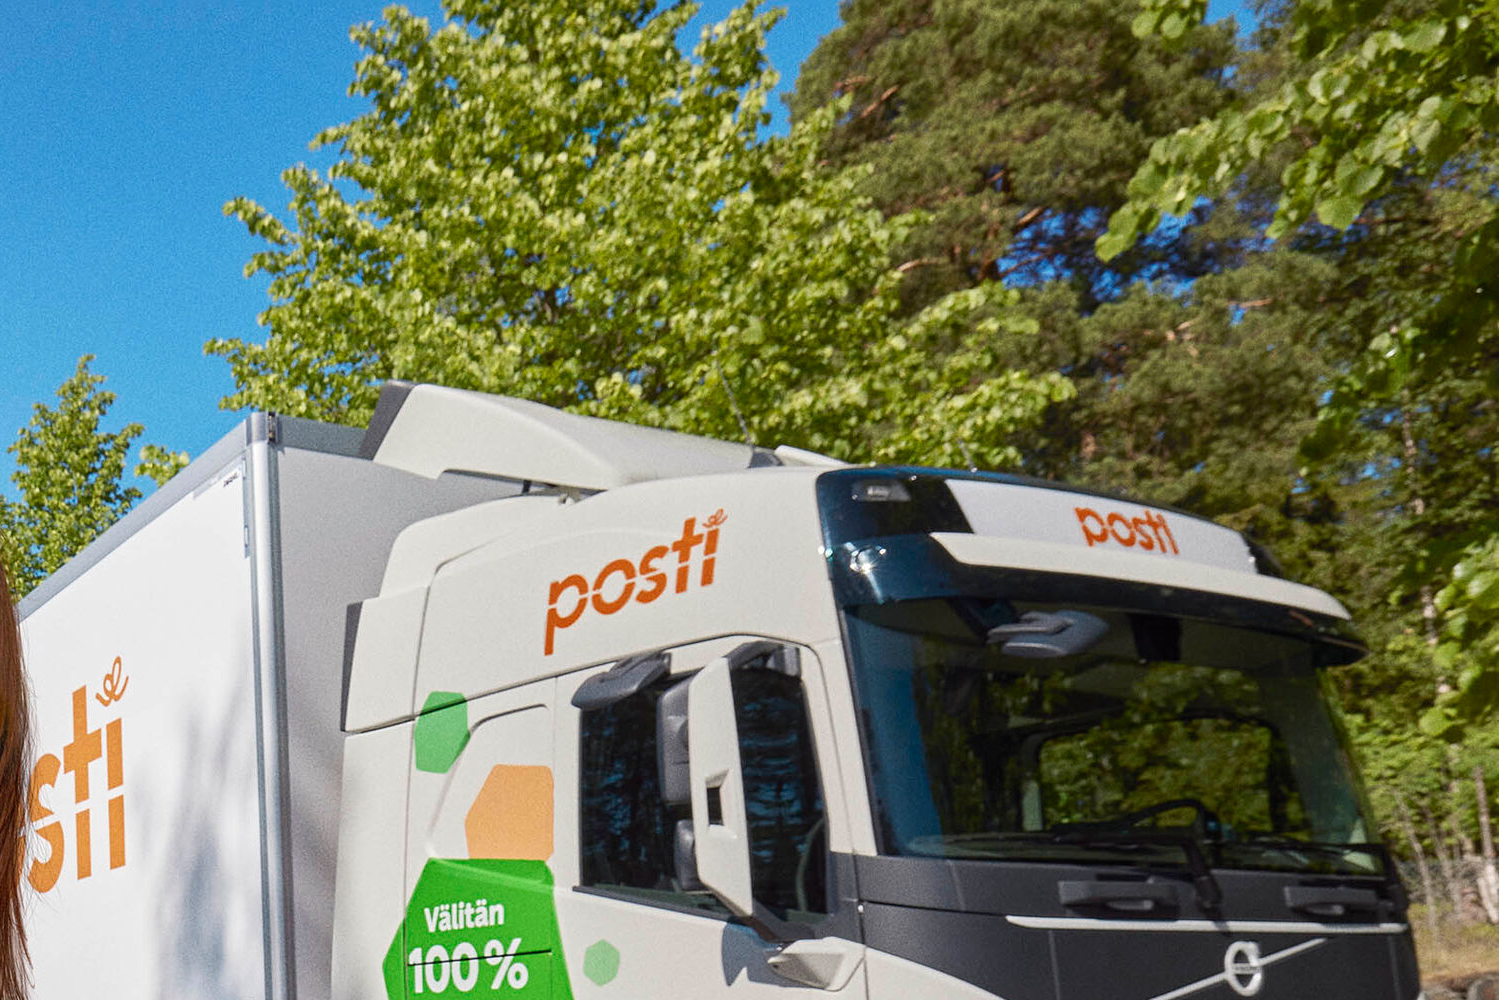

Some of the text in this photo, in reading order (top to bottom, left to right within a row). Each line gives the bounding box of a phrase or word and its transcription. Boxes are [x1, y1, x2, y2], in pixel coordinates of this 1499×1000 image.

[1074, 507, 1180, 555] posti
[544, 508, 728, 656] posti
[18, 656, 129, 893] sti
[423, 898, 505, 933] Välitän
